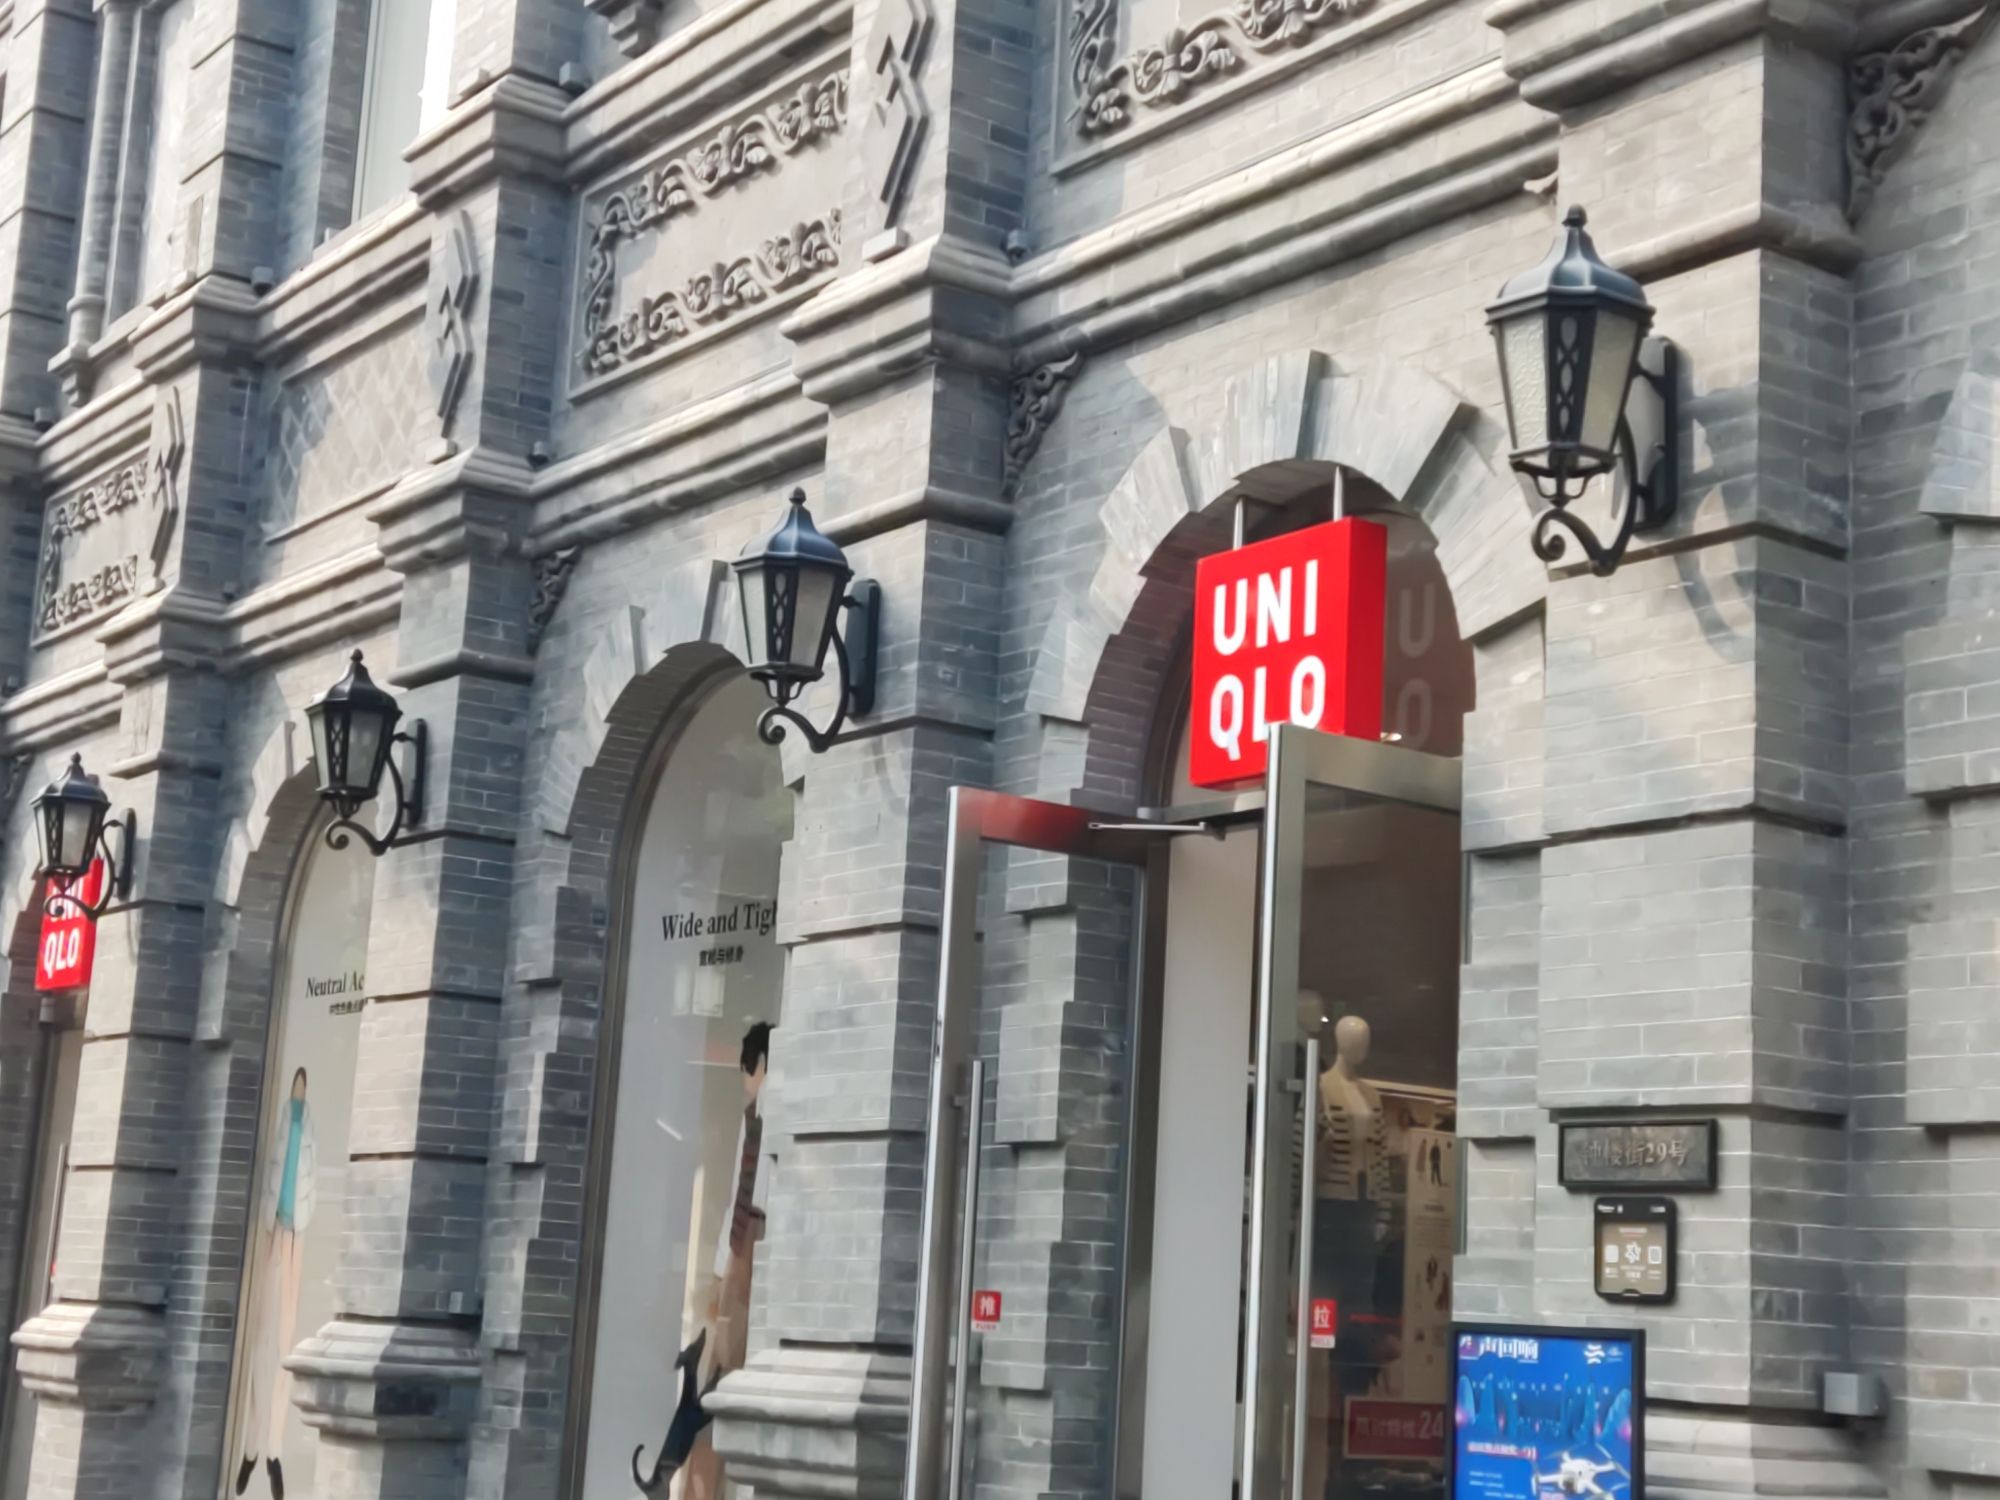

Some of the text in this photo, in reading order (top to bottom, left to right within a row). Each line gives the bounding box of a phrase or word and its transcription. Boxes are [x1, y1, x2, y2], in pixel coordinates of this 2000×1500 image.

[1213, 559, 1318, 656] UNI
[1209, 655, 1326, 761] QLO
[662, 912, 702, 941] Wide
[707, 906, 738, 935] and
[44, 927, 80, 979] QLO
[305, 972, 347, 998] Neutral
[1313, 1304, 1331, 1328] 拉
